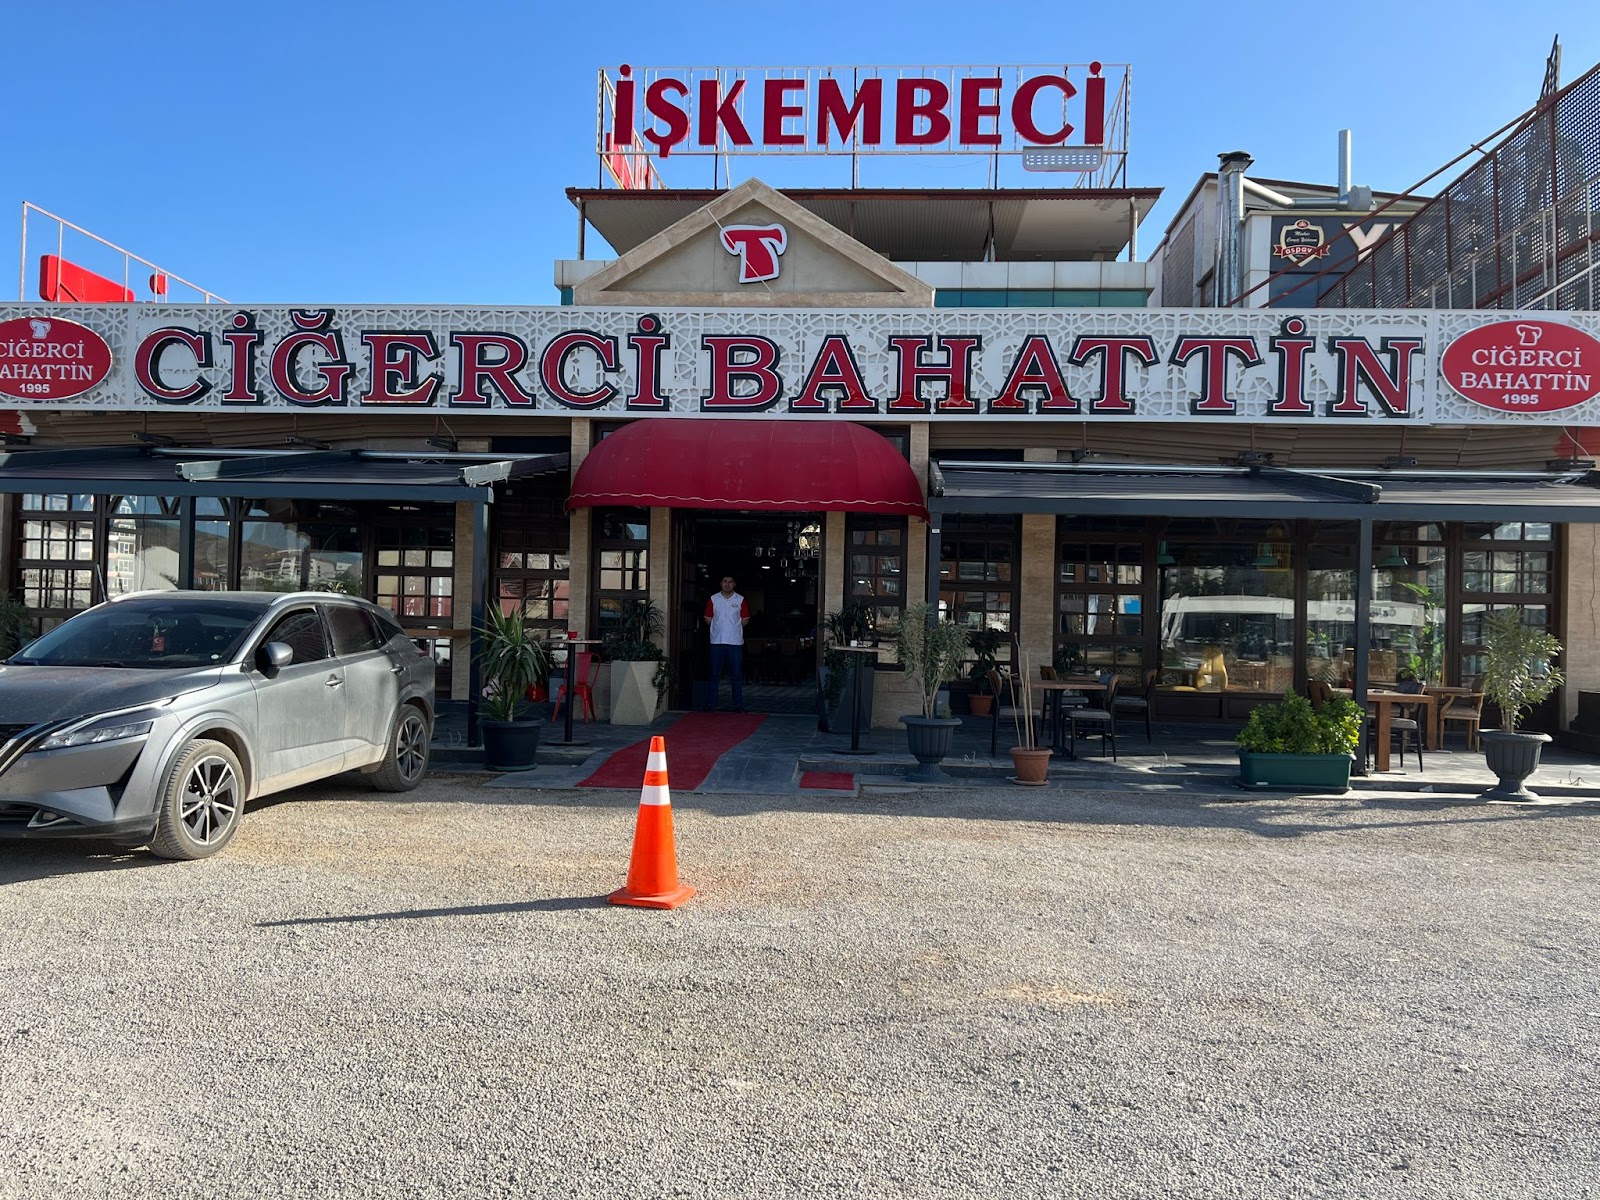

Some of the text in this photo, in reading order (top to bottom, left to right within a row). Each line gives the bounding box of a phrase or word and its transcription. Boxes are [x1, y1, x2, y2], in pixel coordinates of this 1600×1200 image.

[614, 61, 1106, 159] İŞKEMBECİ
[1285, 246, 1317, 255] aspav
[135, 309, 671, 411] CİĞERCİ
[701, 316, 1425, 418] BAHATTİN
[1471, 345, 1583, 368] CİĞERCİ
[0, 361, 93, 381] AHATTİN
[1460, 370, 1592, 391] BAHATTİN
[19, 383, 51, 394] 1995
[1501, 393, 1540, 405] 1995
